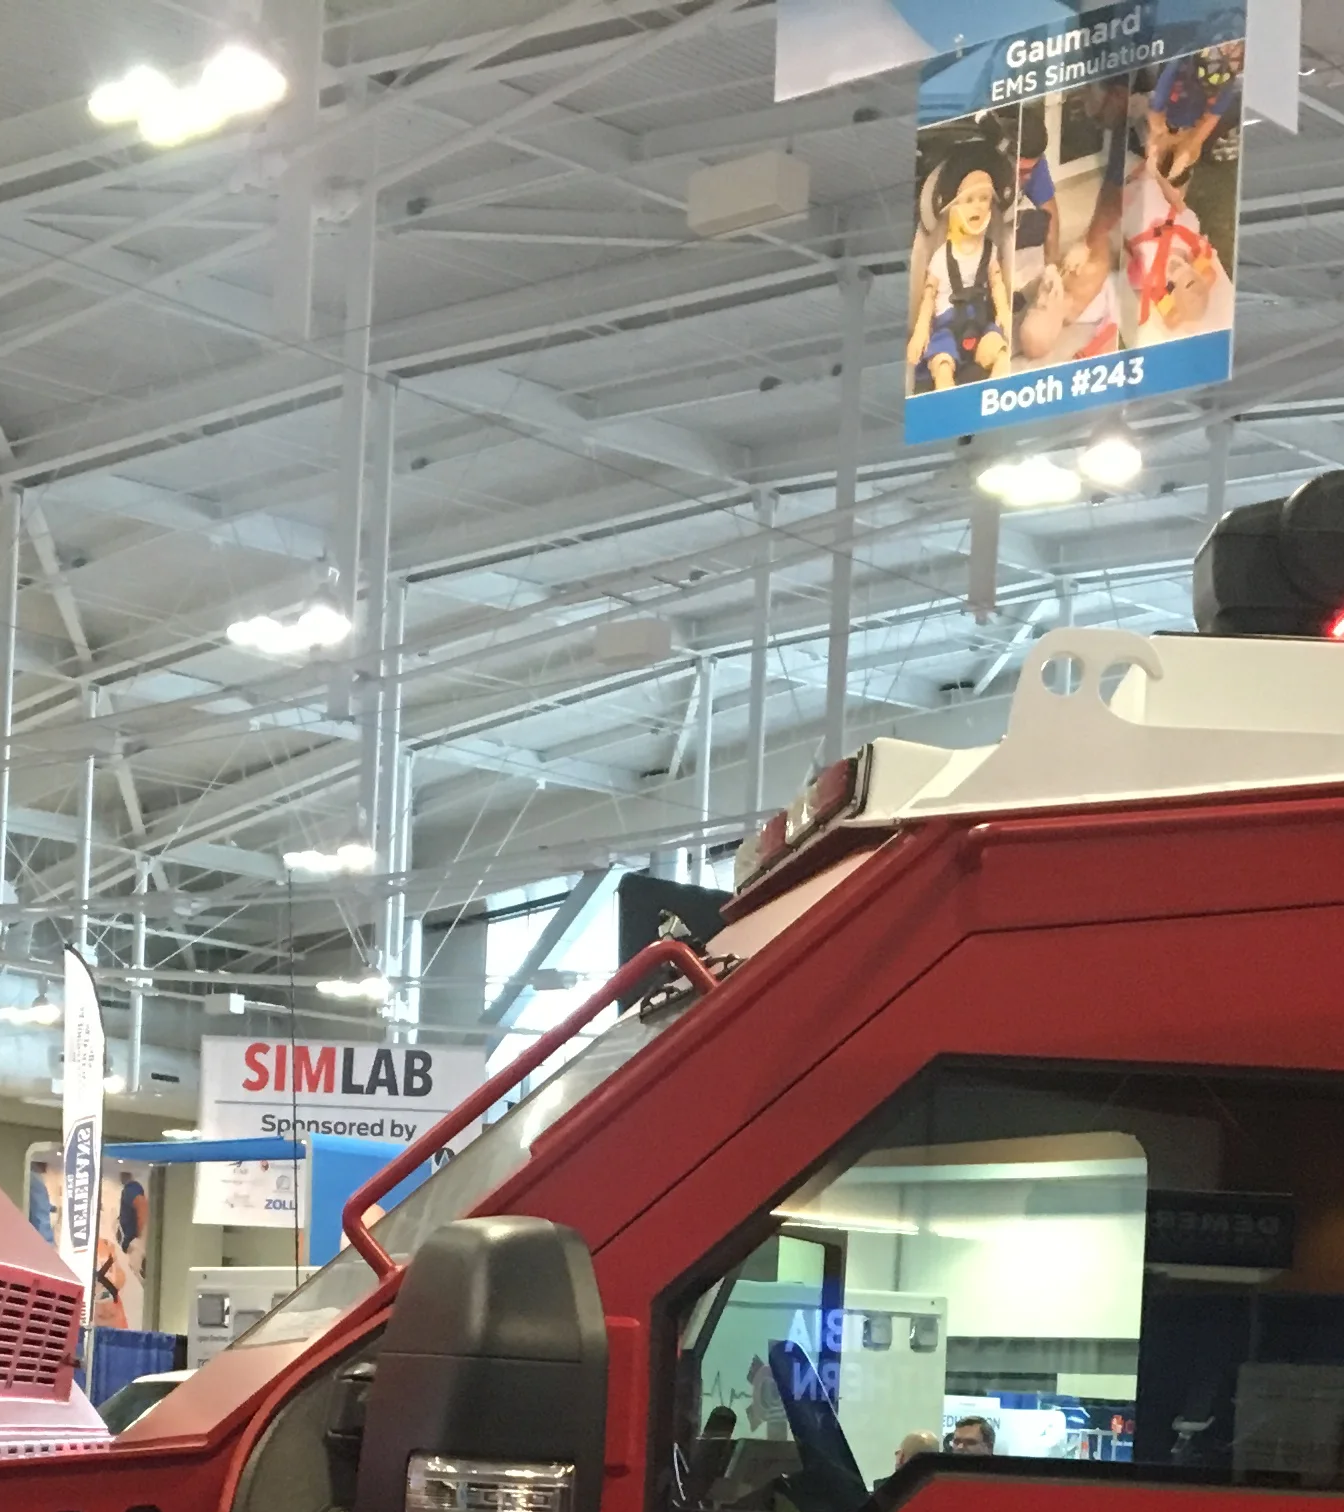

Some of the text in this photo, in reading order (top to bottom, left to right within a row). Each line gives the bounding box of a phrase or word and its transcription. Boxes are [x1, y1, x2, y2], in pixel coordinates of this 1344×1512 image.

[1006, 5, 1142, 68] Gaumard
[991, 39, 1165, 101] EMS Simulation
[980, 356, 1145, 417] Booth #243
[242, 1042, 433, 1097] SIMLAB
[261, 1114, 417, 1141] Sponsored by
[264, 1199, 296, 1210] ZOLL
